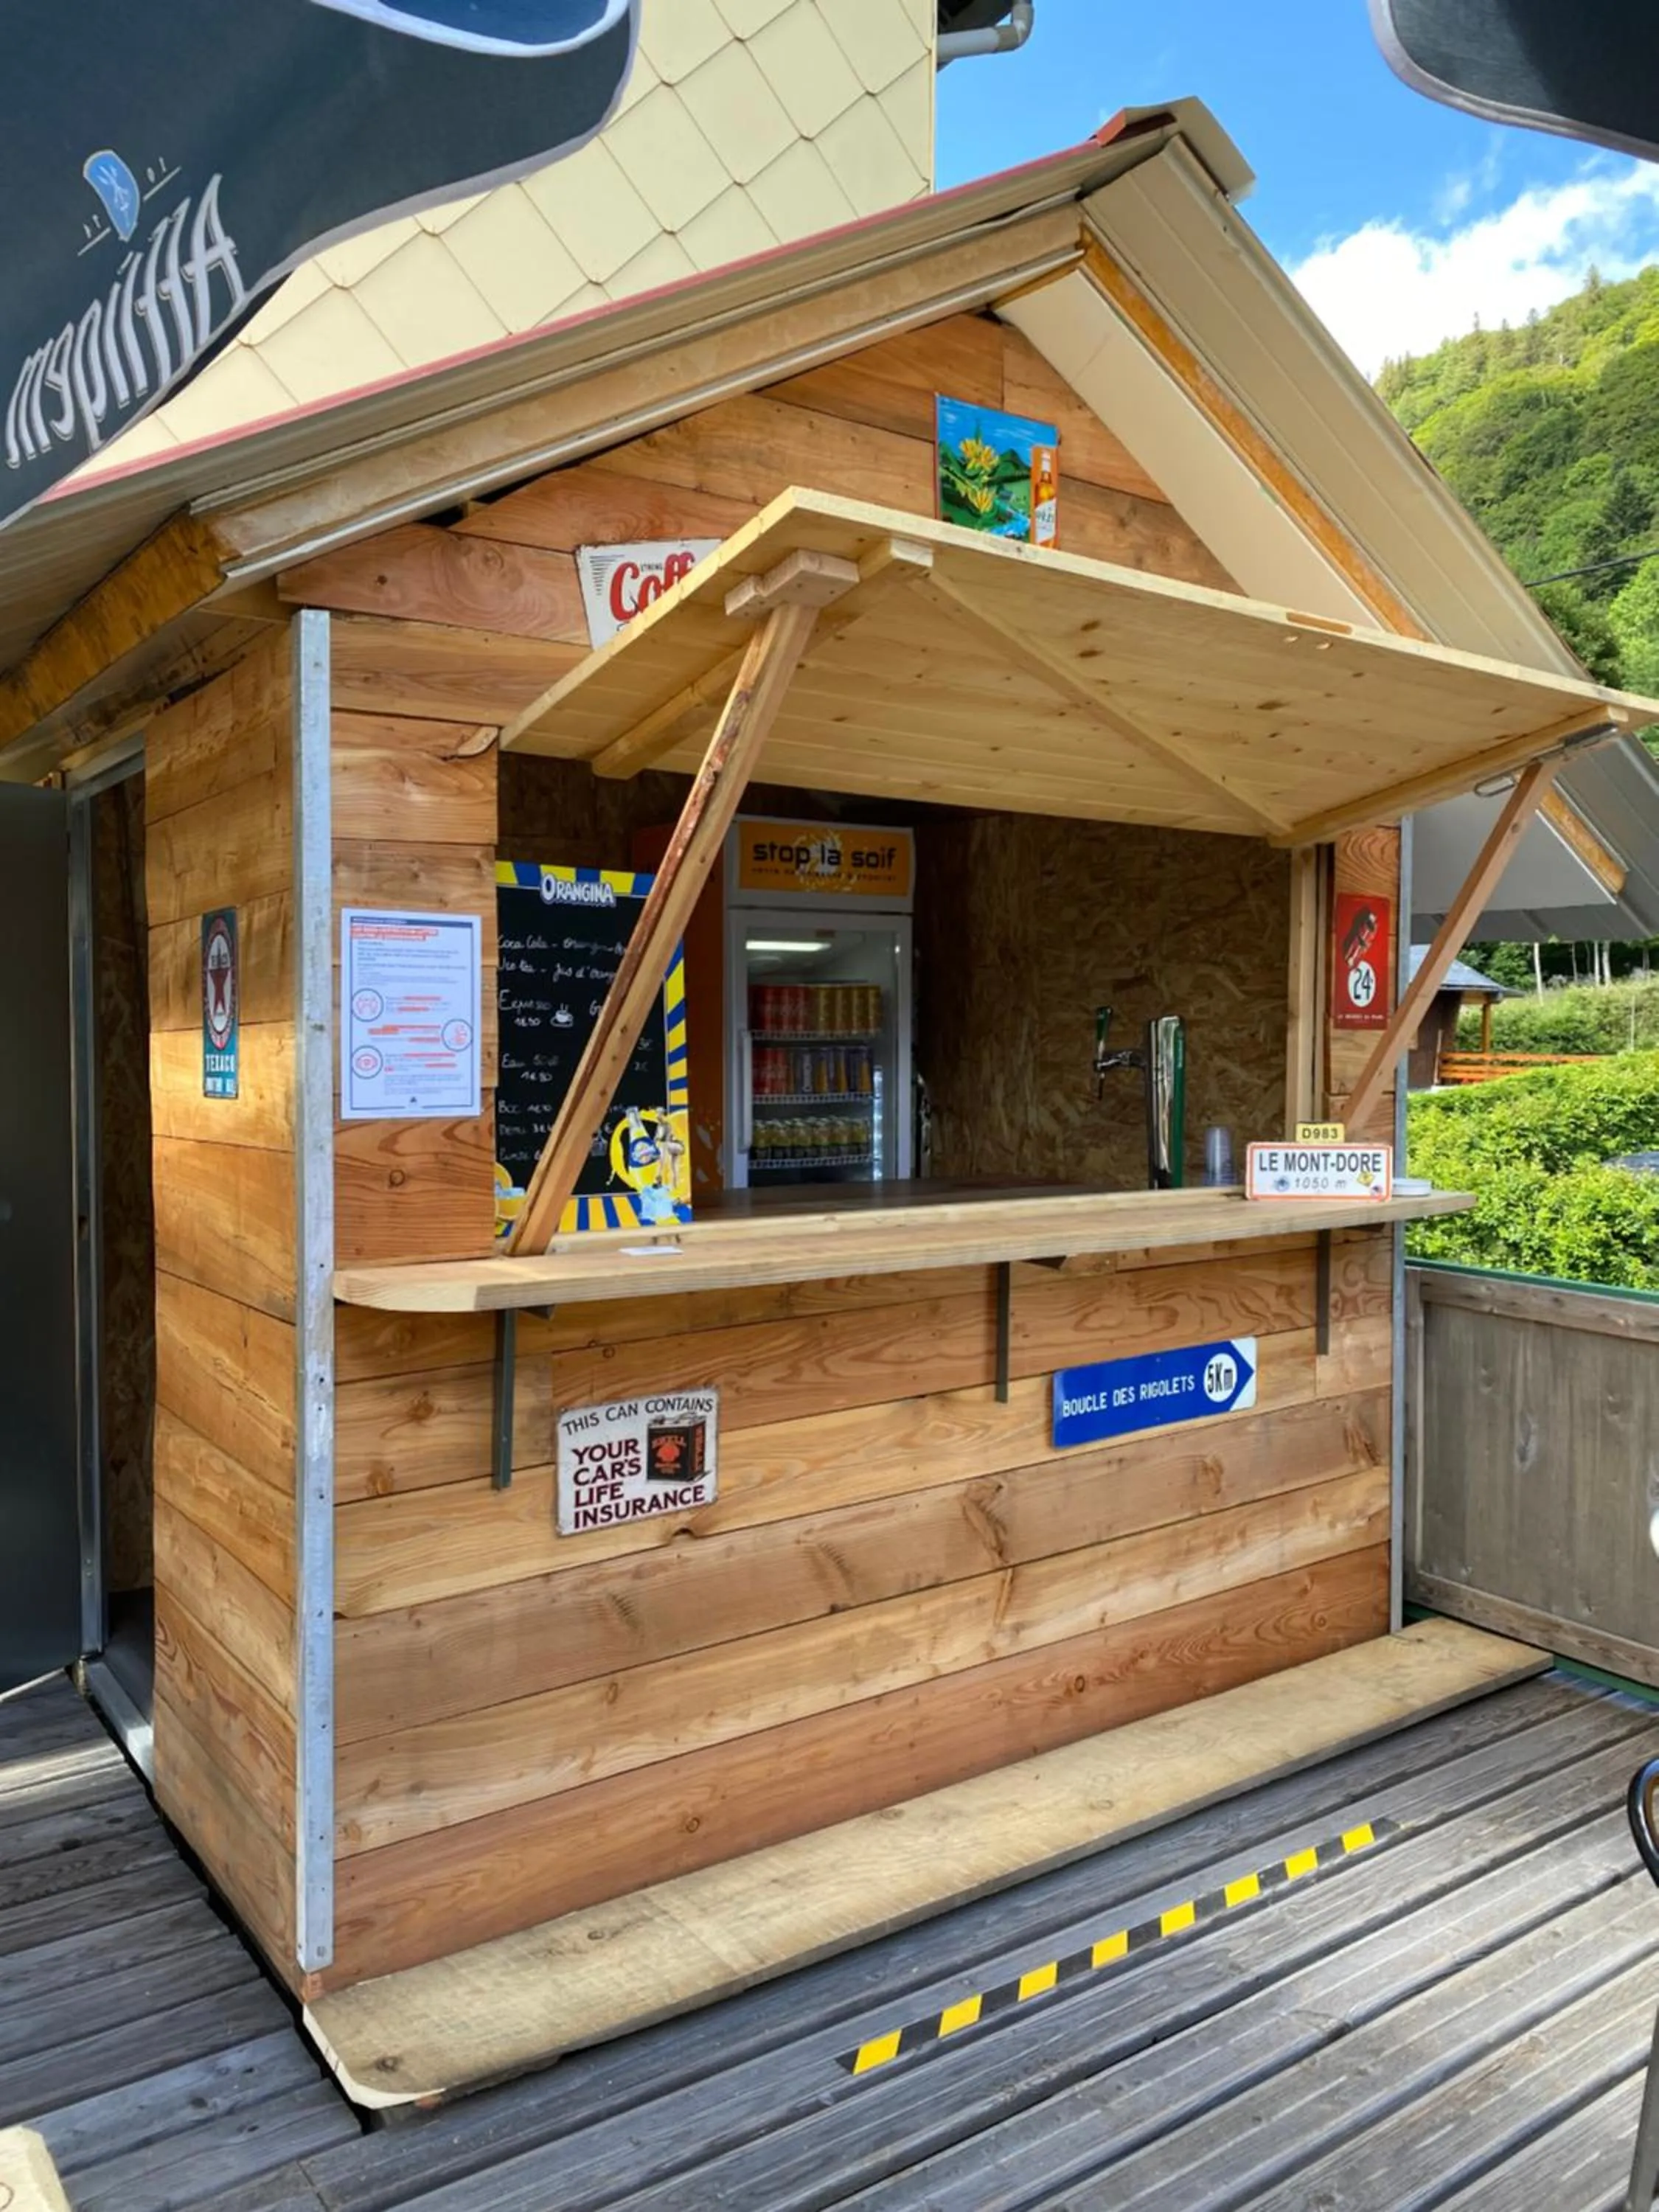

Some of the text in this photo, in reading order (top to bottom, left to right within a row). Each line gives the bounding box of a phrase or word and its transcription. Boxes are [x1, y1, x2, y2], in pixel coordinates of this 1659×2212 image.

[752, 842, 897, 869] stop la soif
[1353, 967, 1372, 1001] 24
[1302, 1128, 1338, 1138] D983
[1259, 1152, 1382, 1172] LE MONT-DORE
[1295, 1177, 1329, 1189] 1050
[1062, 1392, 1108, 1417] BOUCLE
[1113, 1386, 1135, 1407] DES
[1140, 1375, 1195, 1401] RIGOLETS
[563, 1398, 714, 1435] THIS CAN CONTAINS
[572, 1439, 640, 1465] YOUR
[574, 1482, 625, 1508] LIFE
[574, 1485, 705, 1529] INSURANCE
